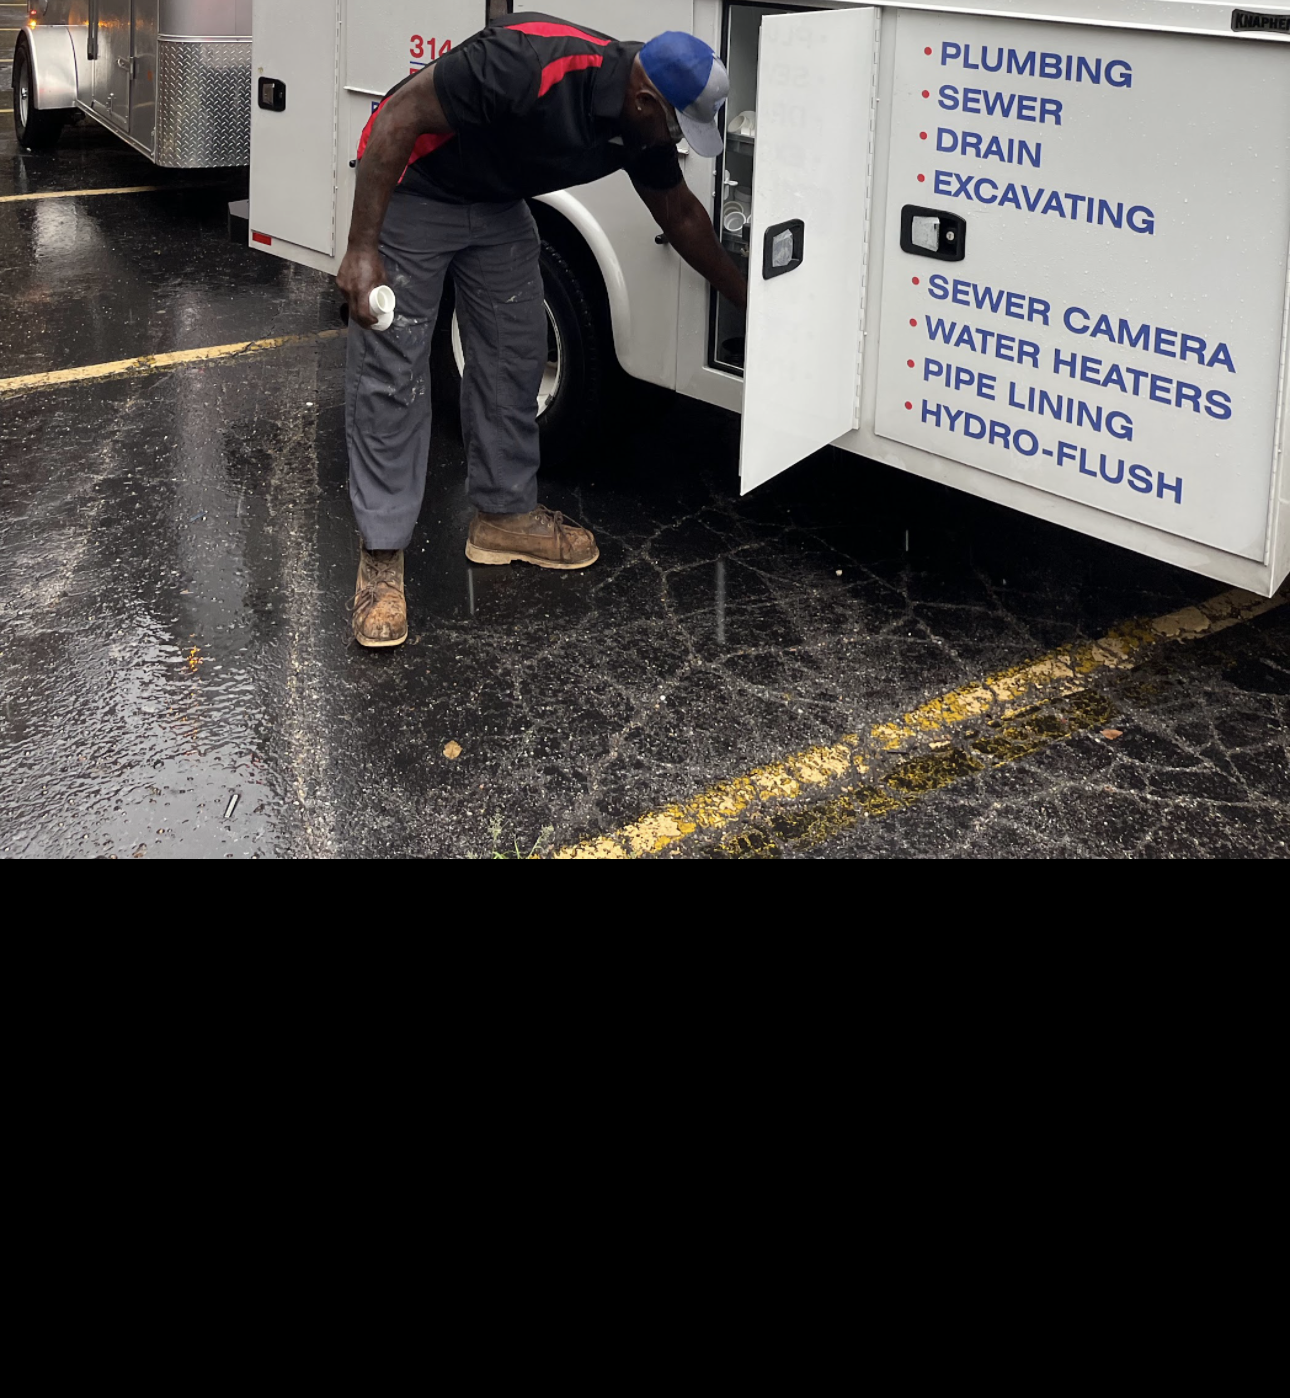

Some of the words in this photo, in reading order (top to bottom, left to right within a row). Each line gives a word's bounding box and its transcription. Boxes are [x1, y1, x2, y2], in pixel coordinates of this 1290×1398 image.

[940, 41, 1133, 88] PLUMBING
[938, 84, 1063, 125] SEWER
[935, 127, 1042, 168] DRAIN
[933, 169, 1155, 235] EXCAVATING
[927, 274, 1051, 326] SEWER
[1062, 306, 1237, 374] CAMERA
[923, 357, 998, 401] PIPE
[1008, 381, 1134, 441] LINING
[924, 315, 1041, 369] WATER
[1053, 348, 1232, 421] HEATERS
[920, 399, 1184, 504] HYDRO-FLUSH
